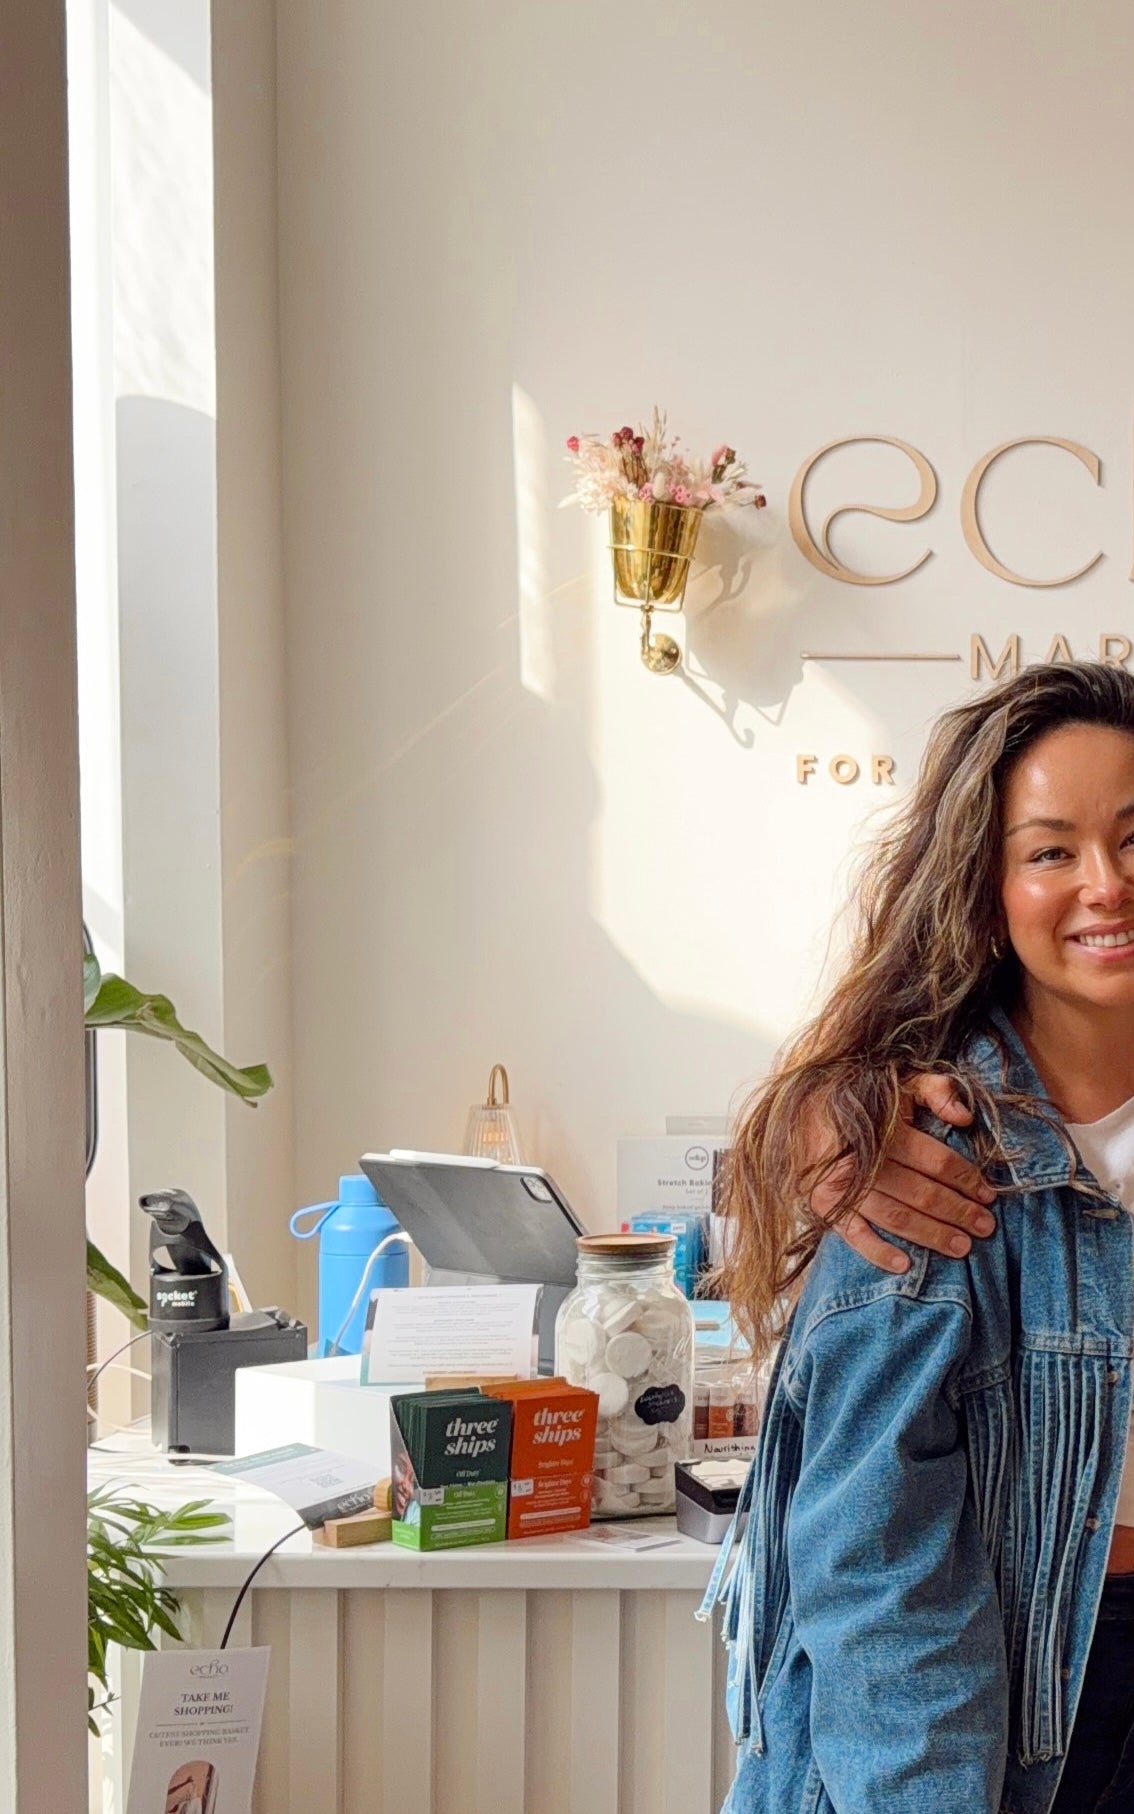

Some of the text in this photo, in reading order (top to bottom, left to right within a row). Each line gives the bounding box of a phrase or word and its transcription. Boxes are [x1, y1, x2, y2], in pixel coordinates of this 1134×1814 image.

[796, 754, 894, 784] FOR
[533, 1408, 585, 1426] three
[445, 1417, 499, 1438] three
[532, 1426, 582, 1447] ships
[444, 1437, 497, 1458] ships
[190, 1659, 229, 1675] echo
[181, 1692, 231, 1703] TAKE ME
[173, 1704, 234, 1716] SHOPPING!
